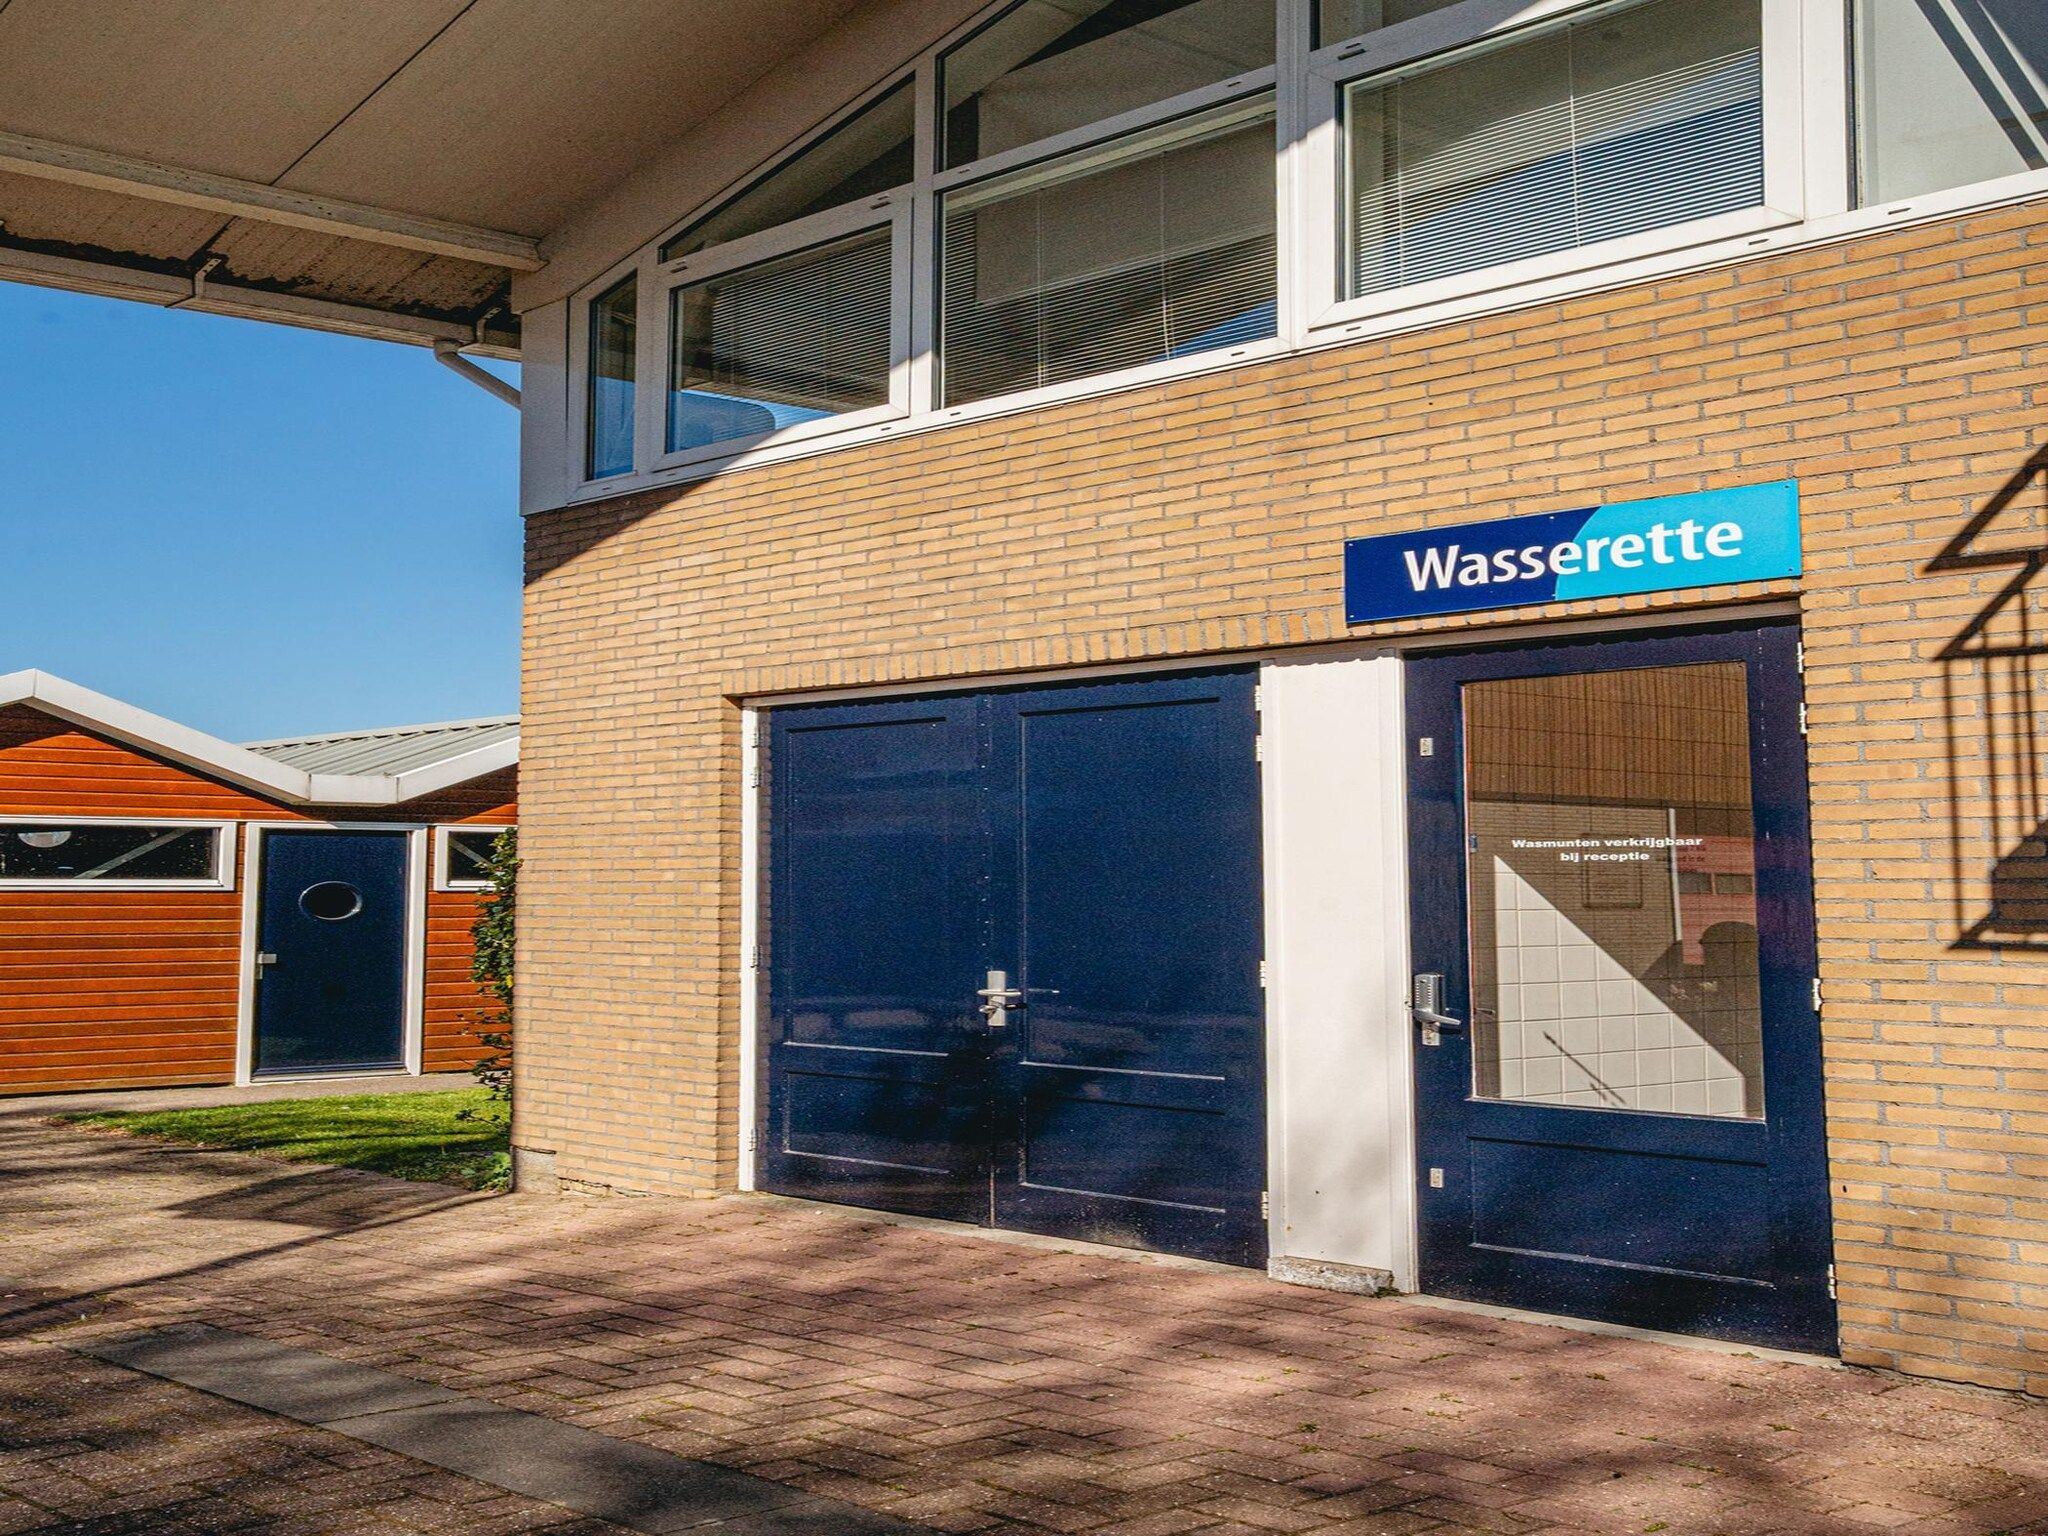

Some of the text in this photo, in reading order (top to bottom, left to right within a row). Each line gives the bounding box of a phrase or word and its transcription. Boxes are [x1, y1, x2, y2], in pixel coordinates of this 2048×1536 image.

[1403, 519, 1742, 592] Wasserette
[1511, 837, 1703, 848] Wasmunten verkrijgbaar
[1560, 851, 1580, 863] bij
[1583, 851, 1650, 864] receptie
